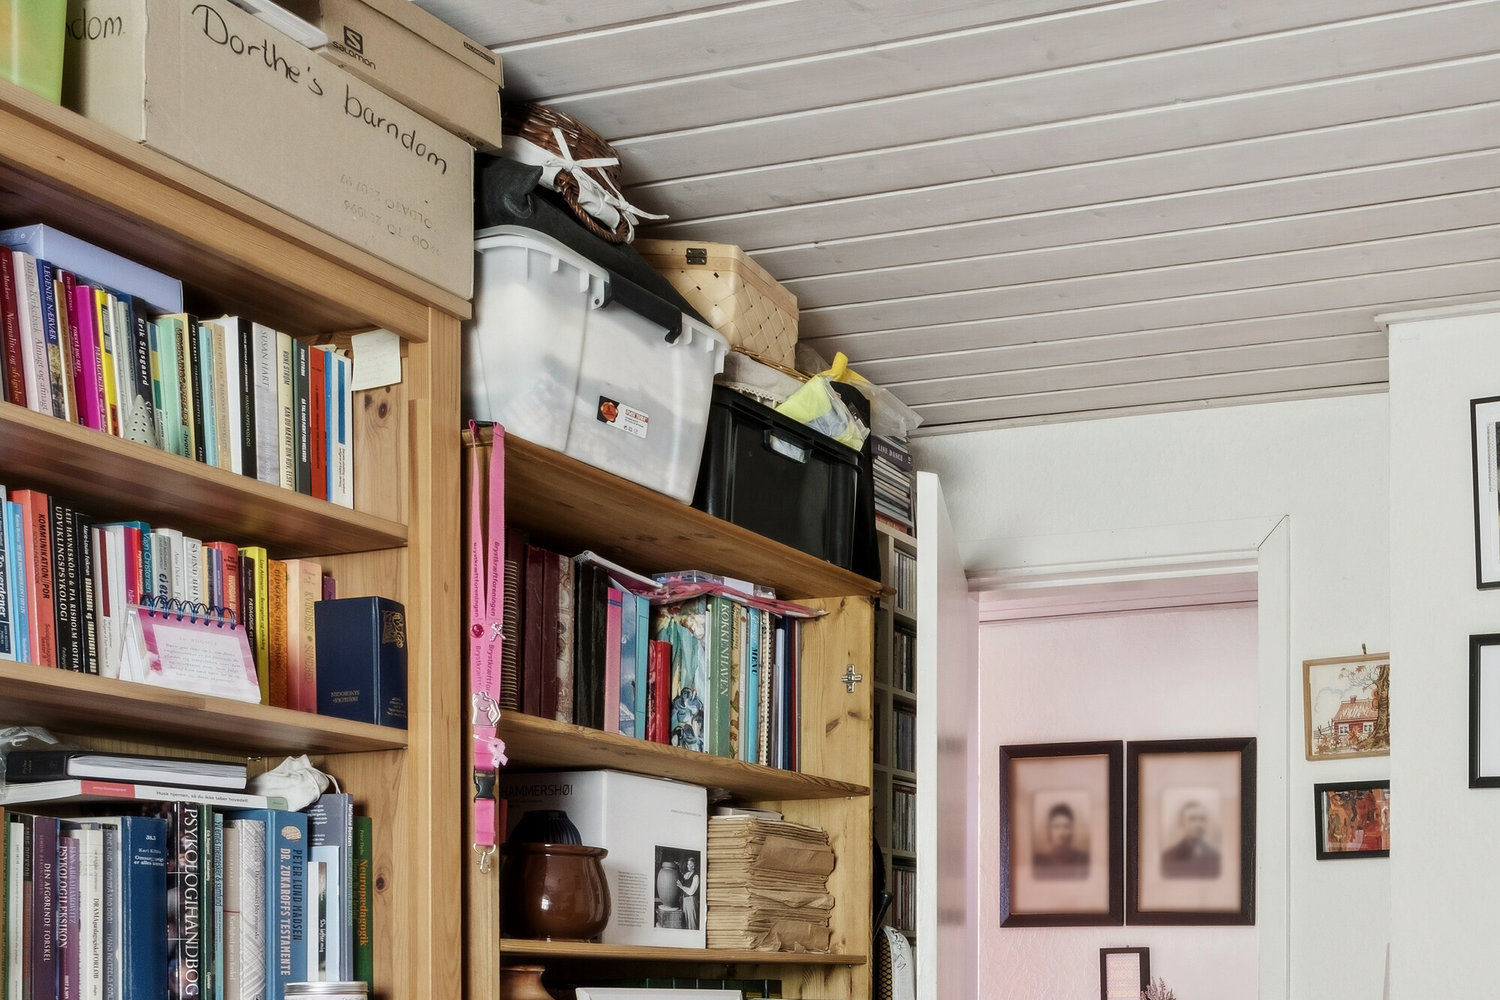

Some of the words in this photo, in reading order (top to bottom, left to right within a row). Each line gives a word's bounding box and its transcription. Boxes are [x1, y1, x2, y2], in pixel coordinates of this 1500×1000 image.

[192, 4, 324, 96] Dorthe's
[344, 84, 447, 175] barndom
[43, 265, 52, 301] LEGENDE
[6, 312, 17, 353] Normalitet
[47, 303, 56, 340] NÆRVÆR
[137, 318, 145, 337] Erik
[35, 338, 45, 367] Almagt
[139, 341, 149, 385] Sigsgaard
[11, 367, 21, 401] afvigelse
[38, 370, 45, 381] og
[39, 383, 48, 410] afmagt
[55, 506, 67, 621] UDVIKLINGSPSYKOLOGI
[144, 552, 152, 592] Christensen
[491, 542, 500, 617] Brystkræftforeningen
[720, 604, 729, 696] KØKKENHAVEN
[501, 784, 573, 797] HAMMERSHØI
[280, 848, 290, 862] DR.
[292, 849, 302, 876] PETER
[184, 808, 198, 996] PSYKOLOGIHANDBOG
[280, 865, 290, 915] ZUKAROFFS
[293, 879, 302, 902] LUND
[359, 859, 369, 946] Neuropædagogik
[293, 905, 302, 940] MADSEN
[280, 919, 290, 975] TESTAMENTE
